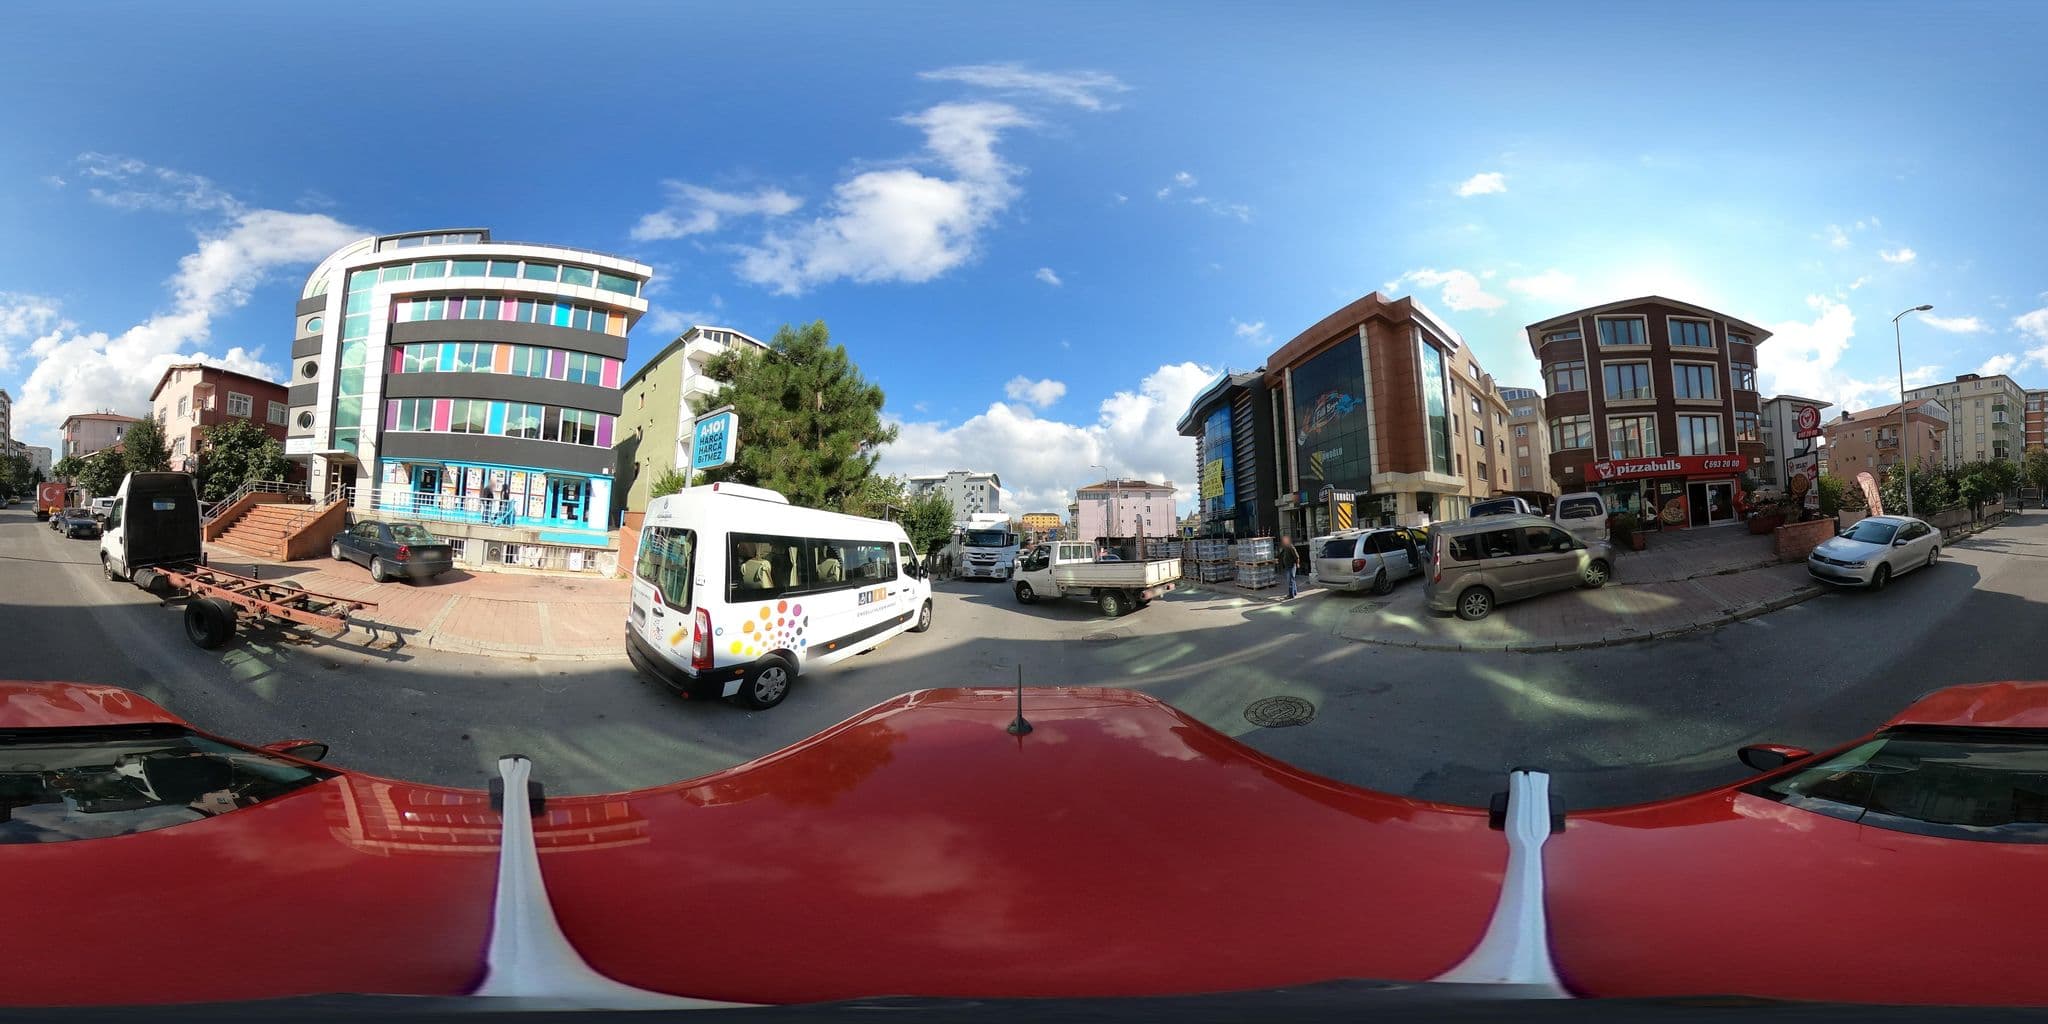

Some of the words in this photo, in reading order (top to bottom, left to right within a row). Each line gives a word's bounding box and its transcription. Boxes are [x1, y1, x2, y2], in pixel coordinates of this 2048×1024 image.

[700, 432, 723, 446] HARCA
[698, 442, 722, 455] HARCA
[1616, 460, 1681, 476] pizzabulls
